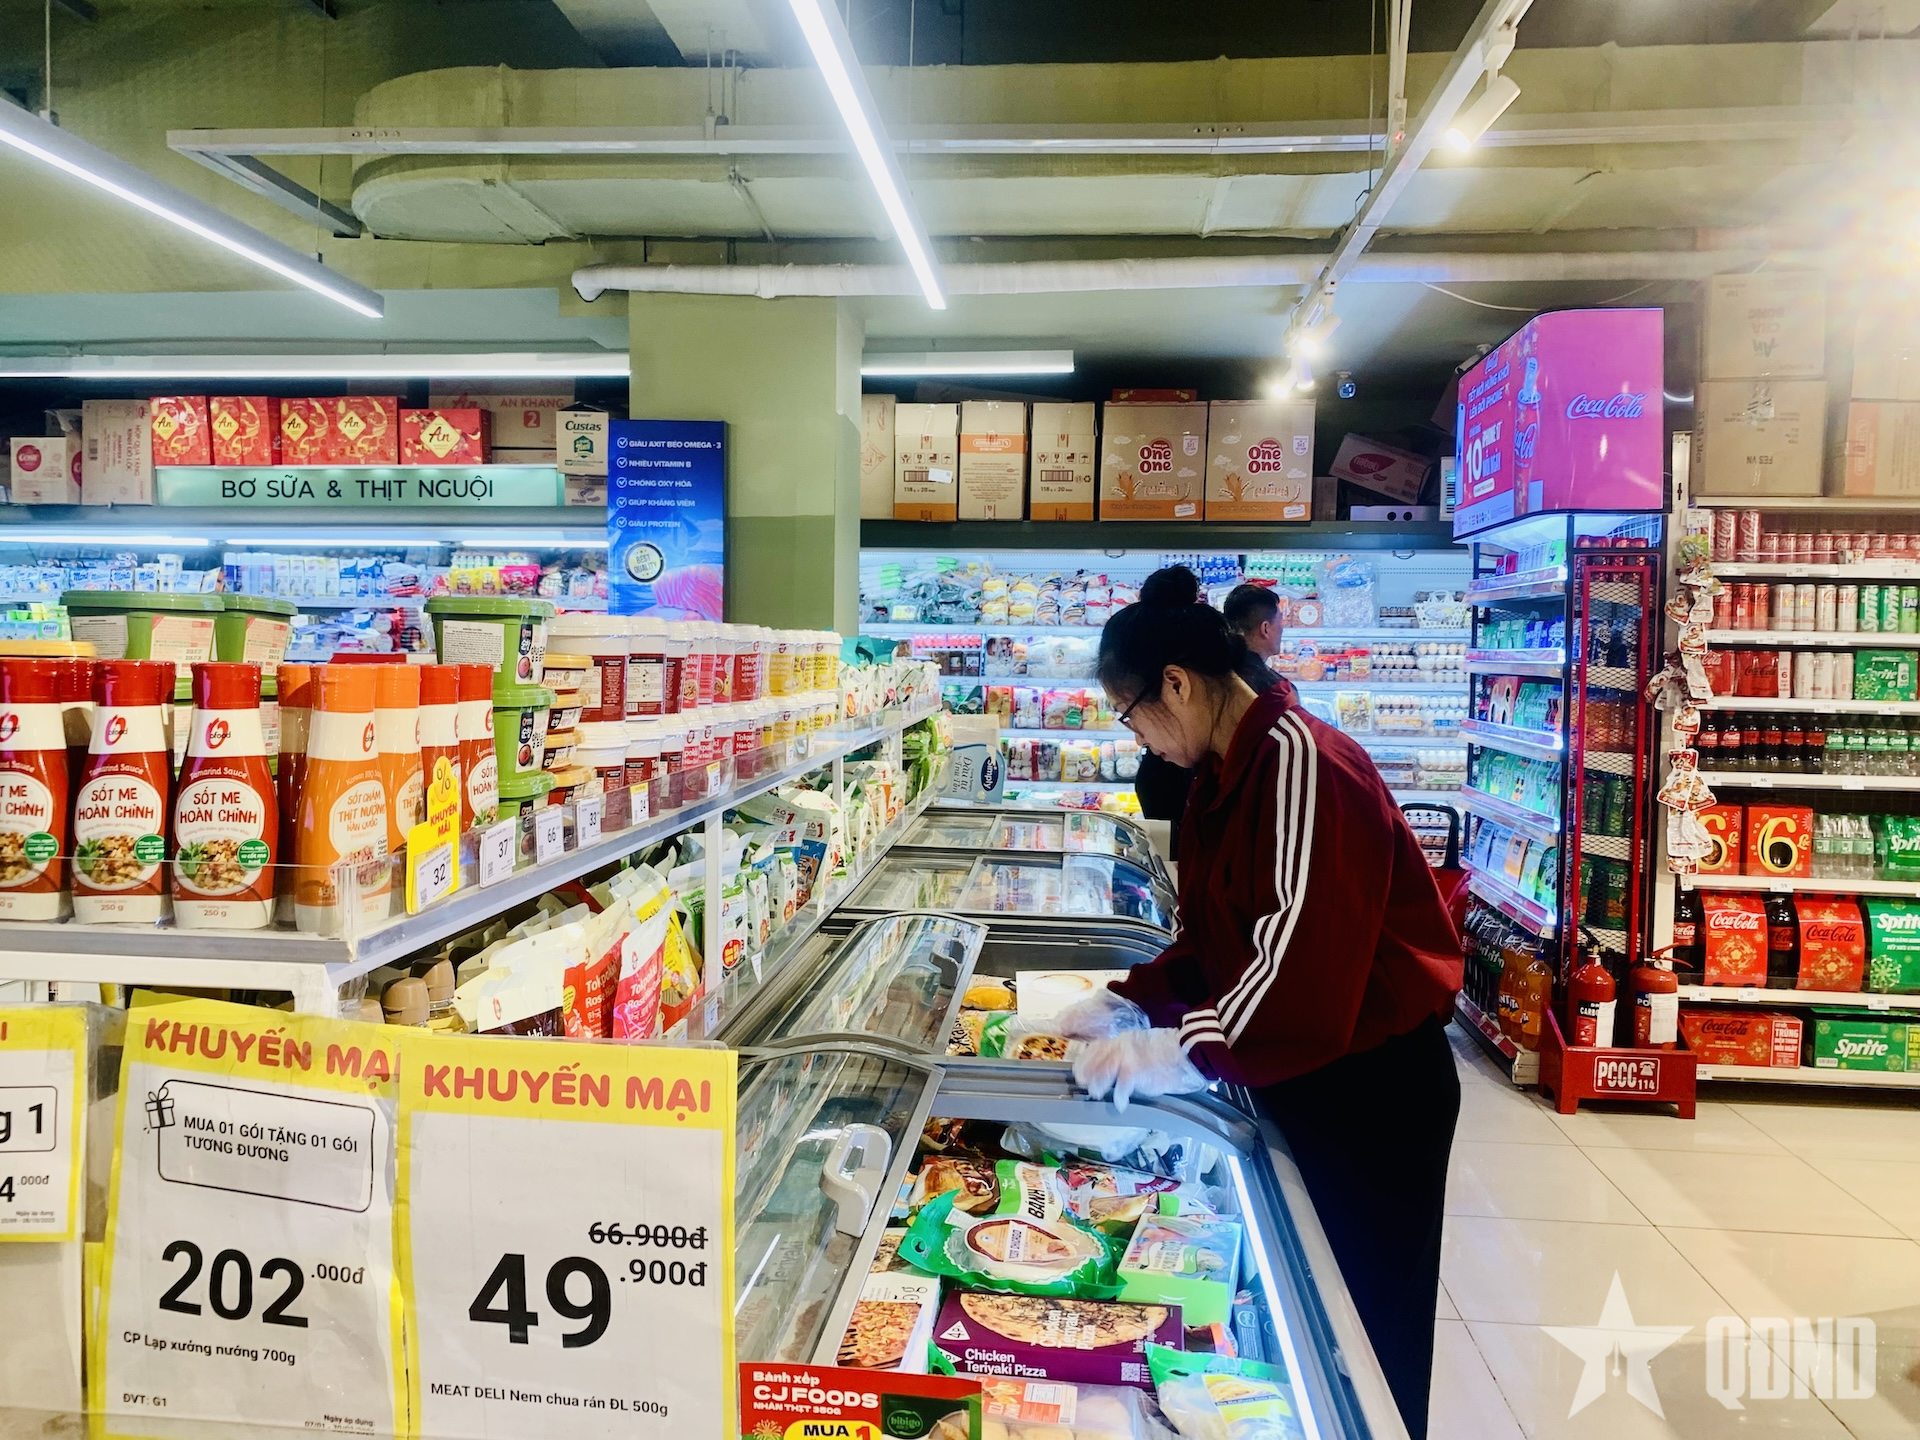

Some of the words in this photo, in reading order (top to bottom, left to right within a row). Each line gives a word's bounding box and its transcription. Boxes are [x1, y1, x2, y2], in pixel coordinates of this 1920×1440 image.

[429, 425, 452, 443] An
[565, 420, 602, 432] Custas
[1140, 446, 1173, 461] One
[1248, 446, 1281, 461] One
[1465, 439, 1483, 484] 10
[1139, 460, 1173, 474] One
[1248, 460, 1281, 474] One
[222, 477, 257, 498] BƠ
[267, 474, 315, 498] SỮA
[327, 480, 342, 498] &
[356, 480, 407, 501] THỊT
[419, 475, 493, 501] NGUỘI
[636, 553, 651, 565] BEST
[633, 561, 658, 574] QUALITY
[209, 731, 232, 740] ofood
[120, 763, 145, 775] Sauce
[189, 768, 222, 779] Tamarind
[223, 767, 249, 779] Sauce
[481, 763, 493, 779] SỐT
[9, 785, 28, 798] ME
[91, 783, 114, 802] SỐT
[118, 787, 138, 801] ME
[193, 786, 217, 805] SỐT
[221, 791, 242, 805] ME
[347, 790, 363, 806] SỐT
[363, 787, 381, 802] CHẤM
[473, 783, 492, 796] HOÀN
[78, 805, 111, 821] HOÀN
[179, 809, 213, 824] HOÀN
[337, 808, 359, 823] THỊT
[430, 801, 458, 827] KHUYẾN
[588, 811, 598, 827] 33
[785, 813, 795, 825] 1
[346, 821, 361, 832] HÀN
[816, 822, 824, 838] 1
[547, 827, 557, 844] 66
[498, 838, 509, 858] 37
[1757, 816, 1799, 874] 6
[433, 863, 446, 886] 32
[118, 905, 124, 913] g
[220, 910, 227, 918] g
[1709, 912, 1759, 930] Coca-Cola
[1806, 924, 1858, 942] Coca-Cola
[1701, 1018, 1752, 1036] Coca-Cola
[145, 1017, 312, 1071] KHUYẾN
[1834, 1038, 1889, 1058] Sprite
[1597, 1061, 1638, 1089] PCCC
[423, 1062, 610, 1108] KHUYẾN
[625, 1075, 711, 1122] MẠI
[1638, 1079, 1656, 1090] 114
[28, 1103, 44, 1135] 1
[184, 1115, 216, 1134] MUA
[218, 1120, 234, 1136] 01
[239, 1119, 265, 1140] GÓI
[268, 1127, 307, 1148] TẶNG
[310, 1134, 328, 1149] 01
[332, 1133, 359, 1154] GÓI
[184, 1135, 233, 1156] TƯƠNG
[236, 1143, 290, 1163] ĐƯƠNG
[588, 1221, 709, 1250] 66.900đ
[159, 1239, 309, 1329] 202
[468, 1253, 612, 1349] 49
[1076, 1324, 1097, 1351] Pizza
[123, 1331, 141, 1345] CP
[144, 1333, 167, 1352] Lạp
[170, 1339, 212, 1357] xưởng
[215, 1342, 259, 1362] nướng
[261, 1348, 296, 1366] 700g
[964, 1348, 1015, 1364] Chicken
[964, 1360, 1013, 1377] Teriyaki
[1014, 1363, 1047, 1378] Pizza
[753, 1371, 791, 1384] Bánh
[123, 1392, 150, 1406] ĐVT:
[152, 1395, 167, 1408] G1
[431, 1382, 471, 1398] MEAT
[474, 1386, 506, 1401] DELI
[509, 1389, 542, 1404] Nem
[546, 1392, 580, 1408] chua
[583, 1395, 606, 1410] rán
[610, 1398, 629, 1412] ĐL
[632, 1399, 669, 1417] 500g
[753, 1385, 788, 1402] CJ
[791, 1386, 879, 1409] FOODS
[753, 1401, 784, 1411] NHÂN
[784, 1403, 812, 1416] THỊT
[812, 1404, 842, 1416] 350G
[324, 1414, 343, 1424] Ngày
[890, 1415, 921, 1428] bibigo
[803, 1424, 850, 1437] MUA
